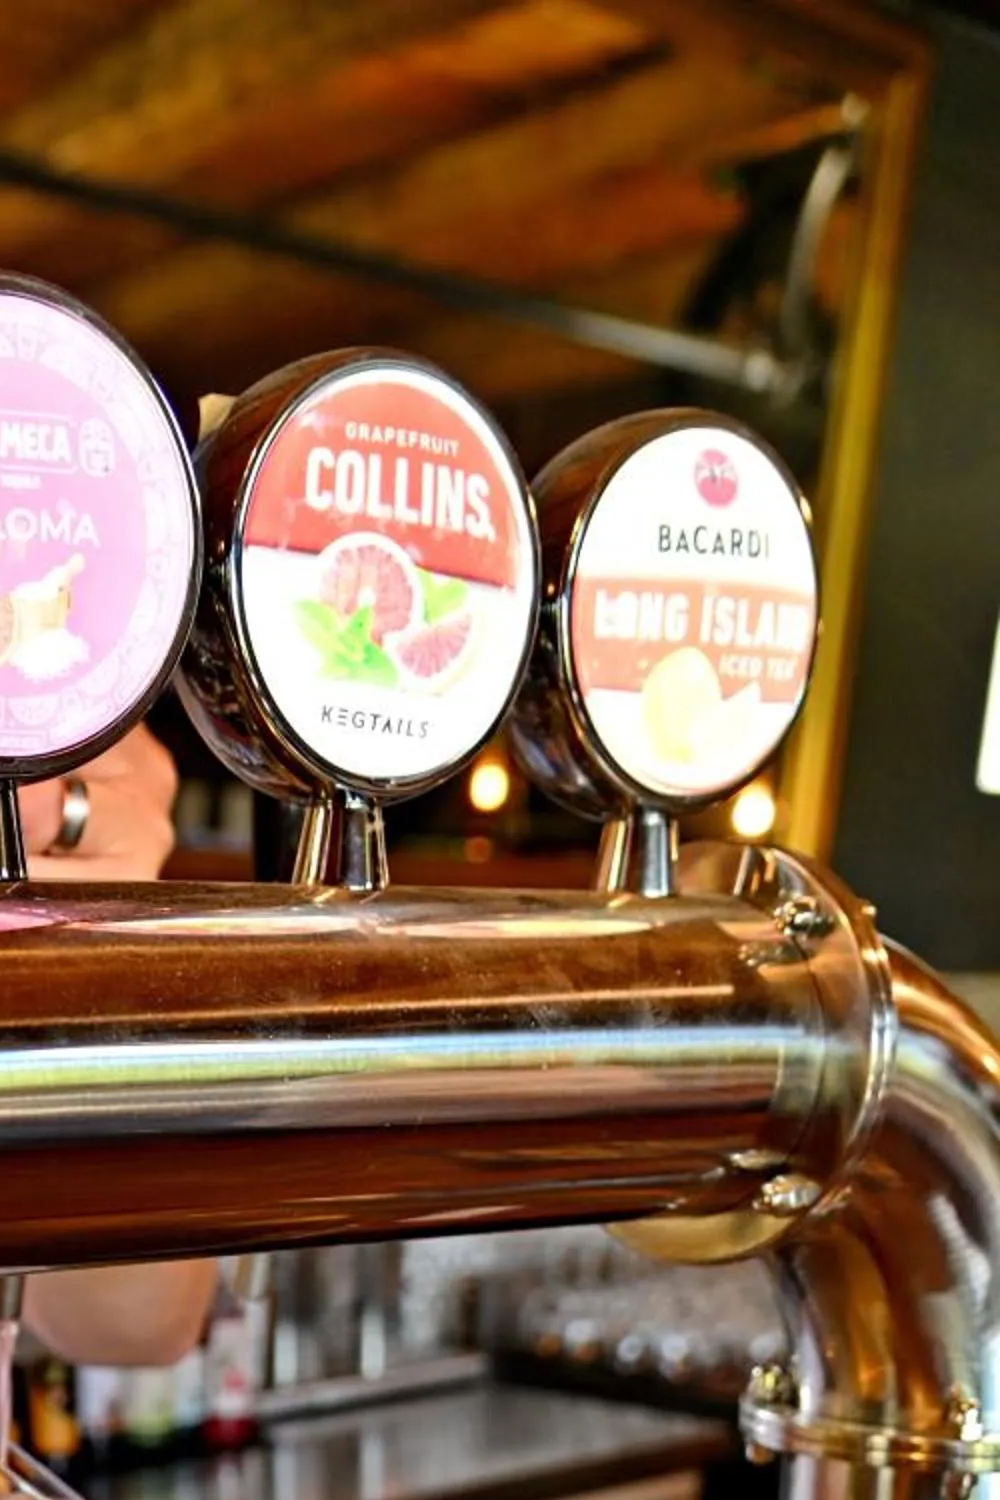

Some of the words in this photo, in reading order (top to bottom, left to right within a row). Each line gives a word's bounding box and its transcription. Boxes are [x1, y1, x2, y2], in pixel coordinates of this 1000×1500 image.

[345, 421, 459, 457] GRAPEFRUIT
[306, 448, 491, 537] COLLINS
[594, 590, 689, 641] LONG
[320, 704, 430, 740] KEGTAILS
